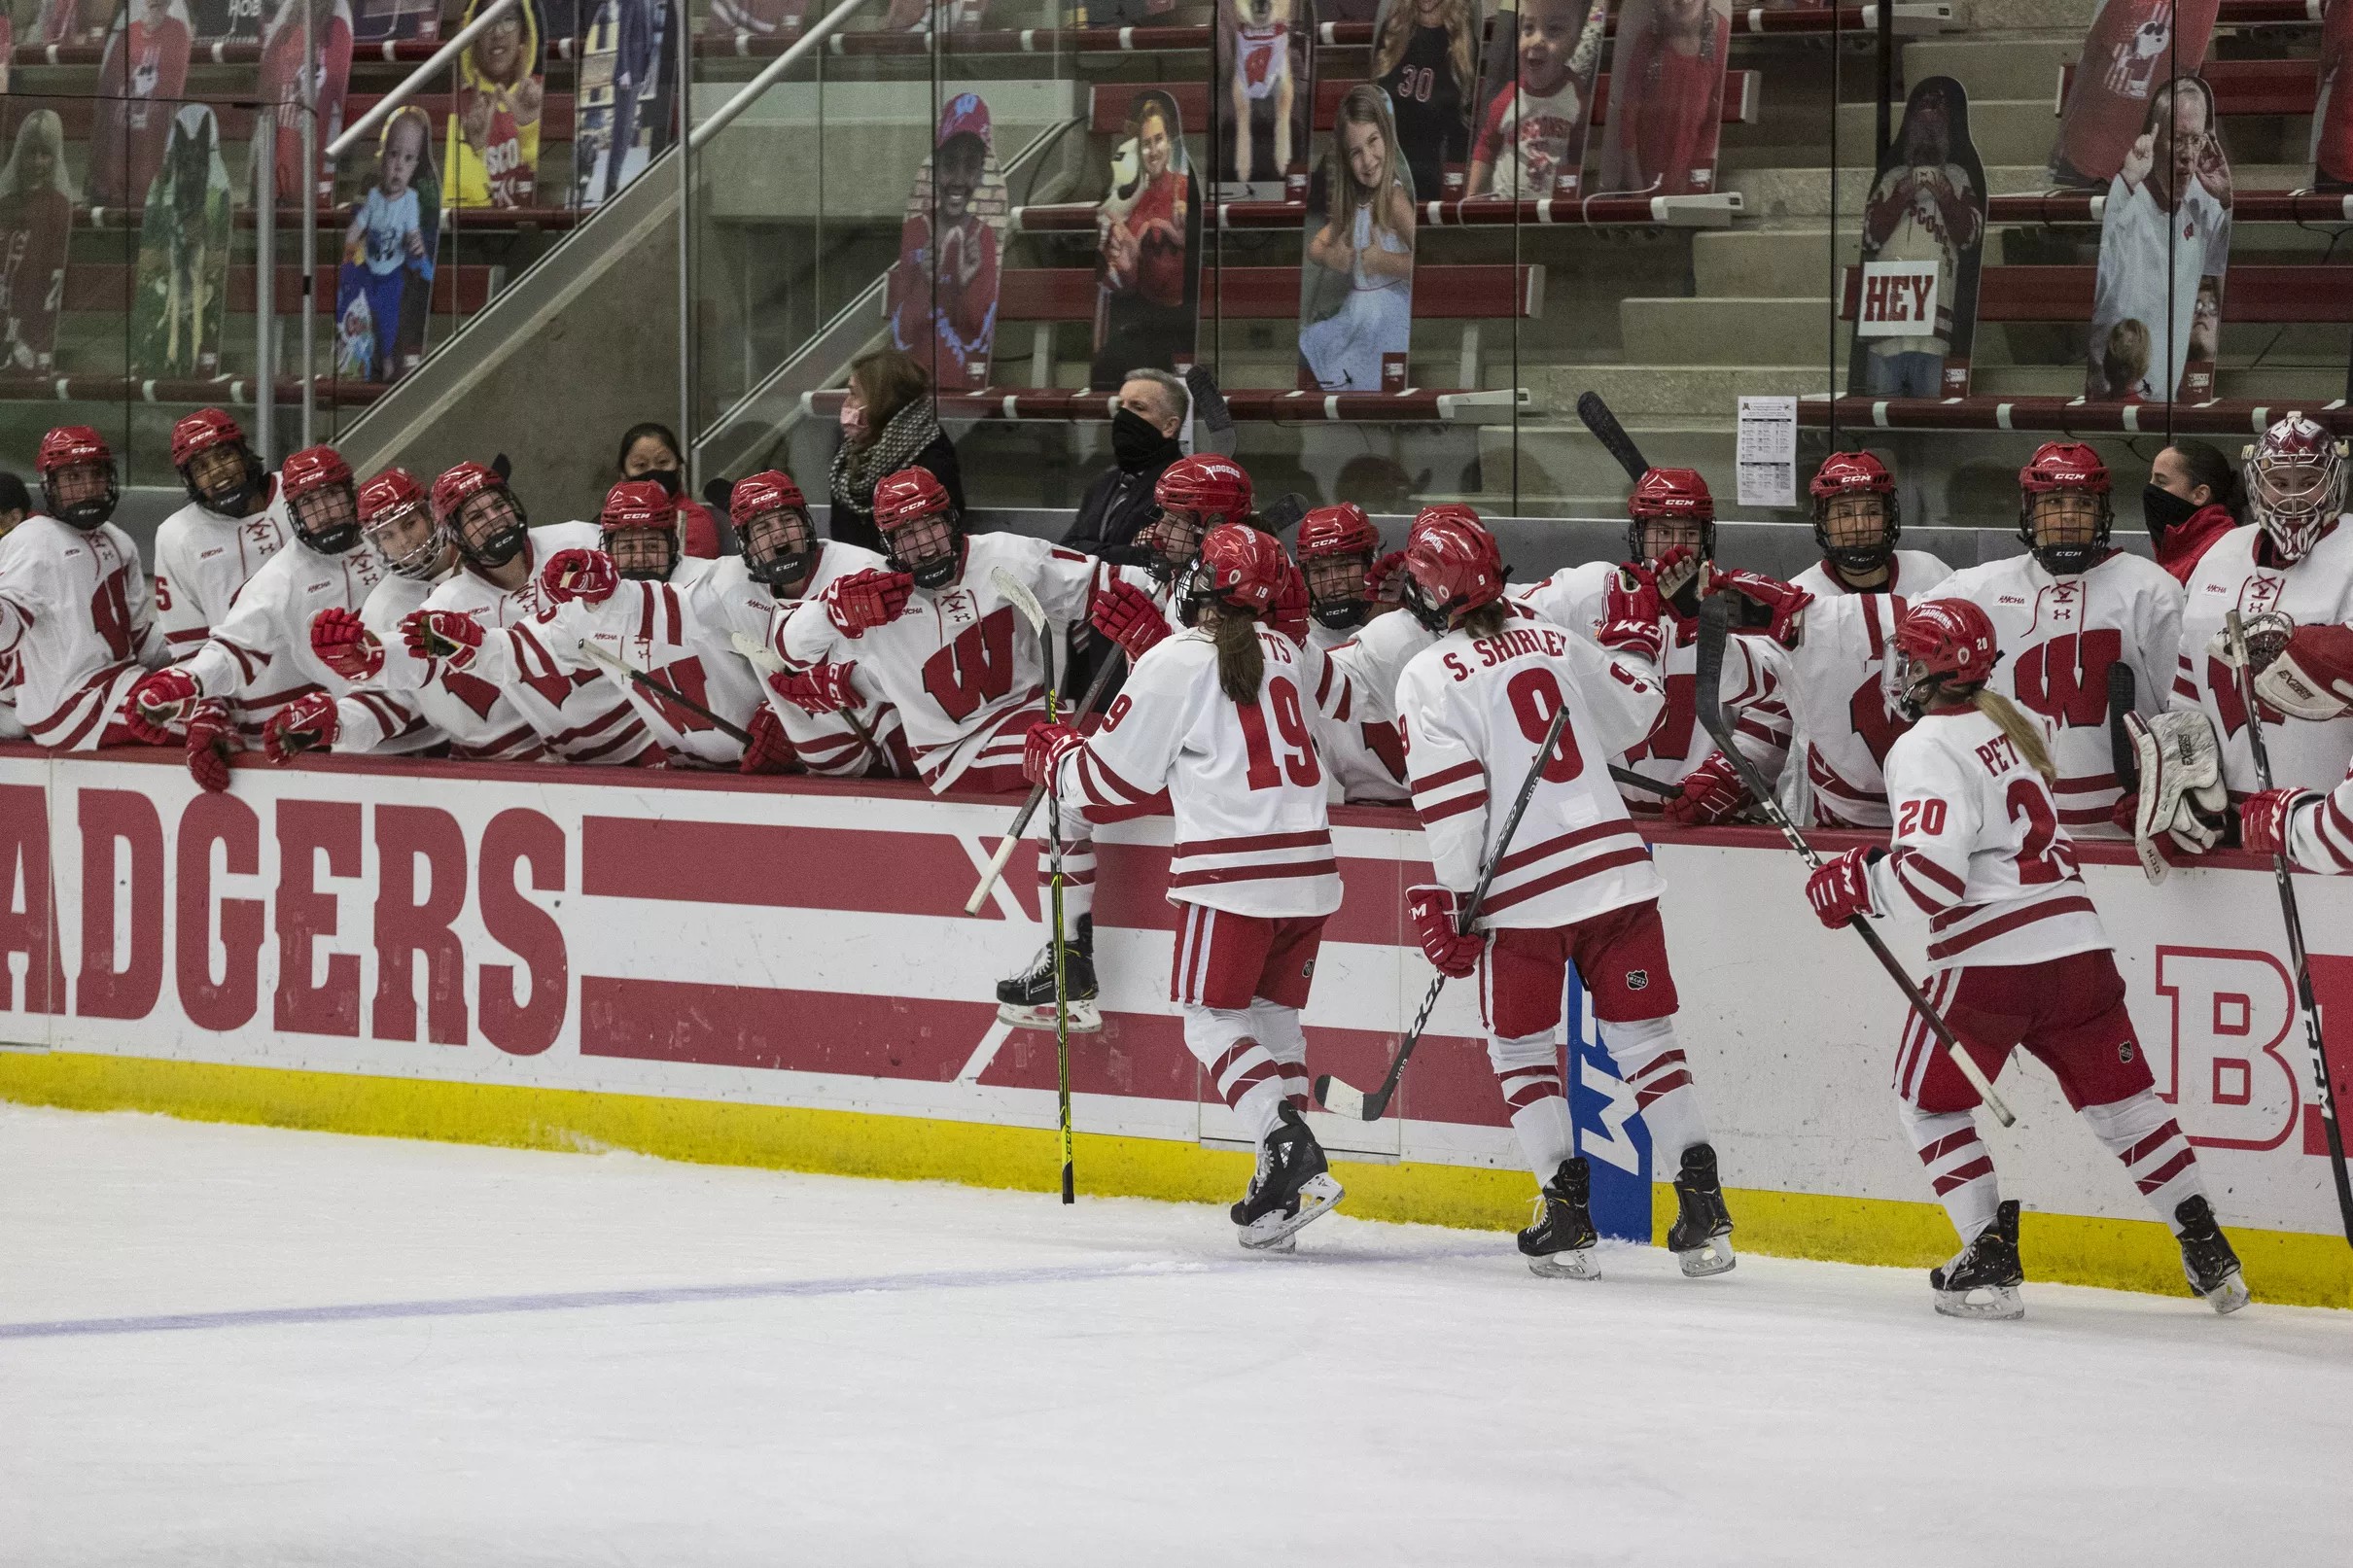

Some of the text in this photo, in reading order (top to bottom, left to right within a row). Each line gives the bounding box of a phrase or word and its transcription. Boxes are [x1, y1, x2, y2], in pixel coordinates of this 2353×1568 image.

[1397, 64, 1434, 103] 30
[1864, 275, 1935, 322] HEY
[190, 430, 215, 445] CCM
[299, 471, 324, 485] CCM
[1842, 474, 1872, 484] CCM
[2054, 472, 2086, 481] CCM
[752, 492, 779, 505] CCM
[371, 504, 395, 518] CCM
[899, 500, 926, 514] CCM
[1311, 538, 1339, 547] CCM
[2282, 526, 2309, 555] 30
[775, 561, 798, 572] CCM
[1478, 574, 1486, 585] 9
[1255, 585, 1269, 600] 19
[1325, 608, 1349, 616] CCM
[1976, 637, 1988, 650] 20
[1443, 629, 1568, 682] S. SHIRLEY
[1610, 661, 1648, 694] 9
[1507, 667, 1584, 784] 9
[1235, 676, 1321, 791] 19
[1525, 776, 1540, 801] CCM
[1898, 798, 1948, 839] 20
[2146, 849, 2160, 875] CCM
[1395, 1059, 1408, 1080] CCM
